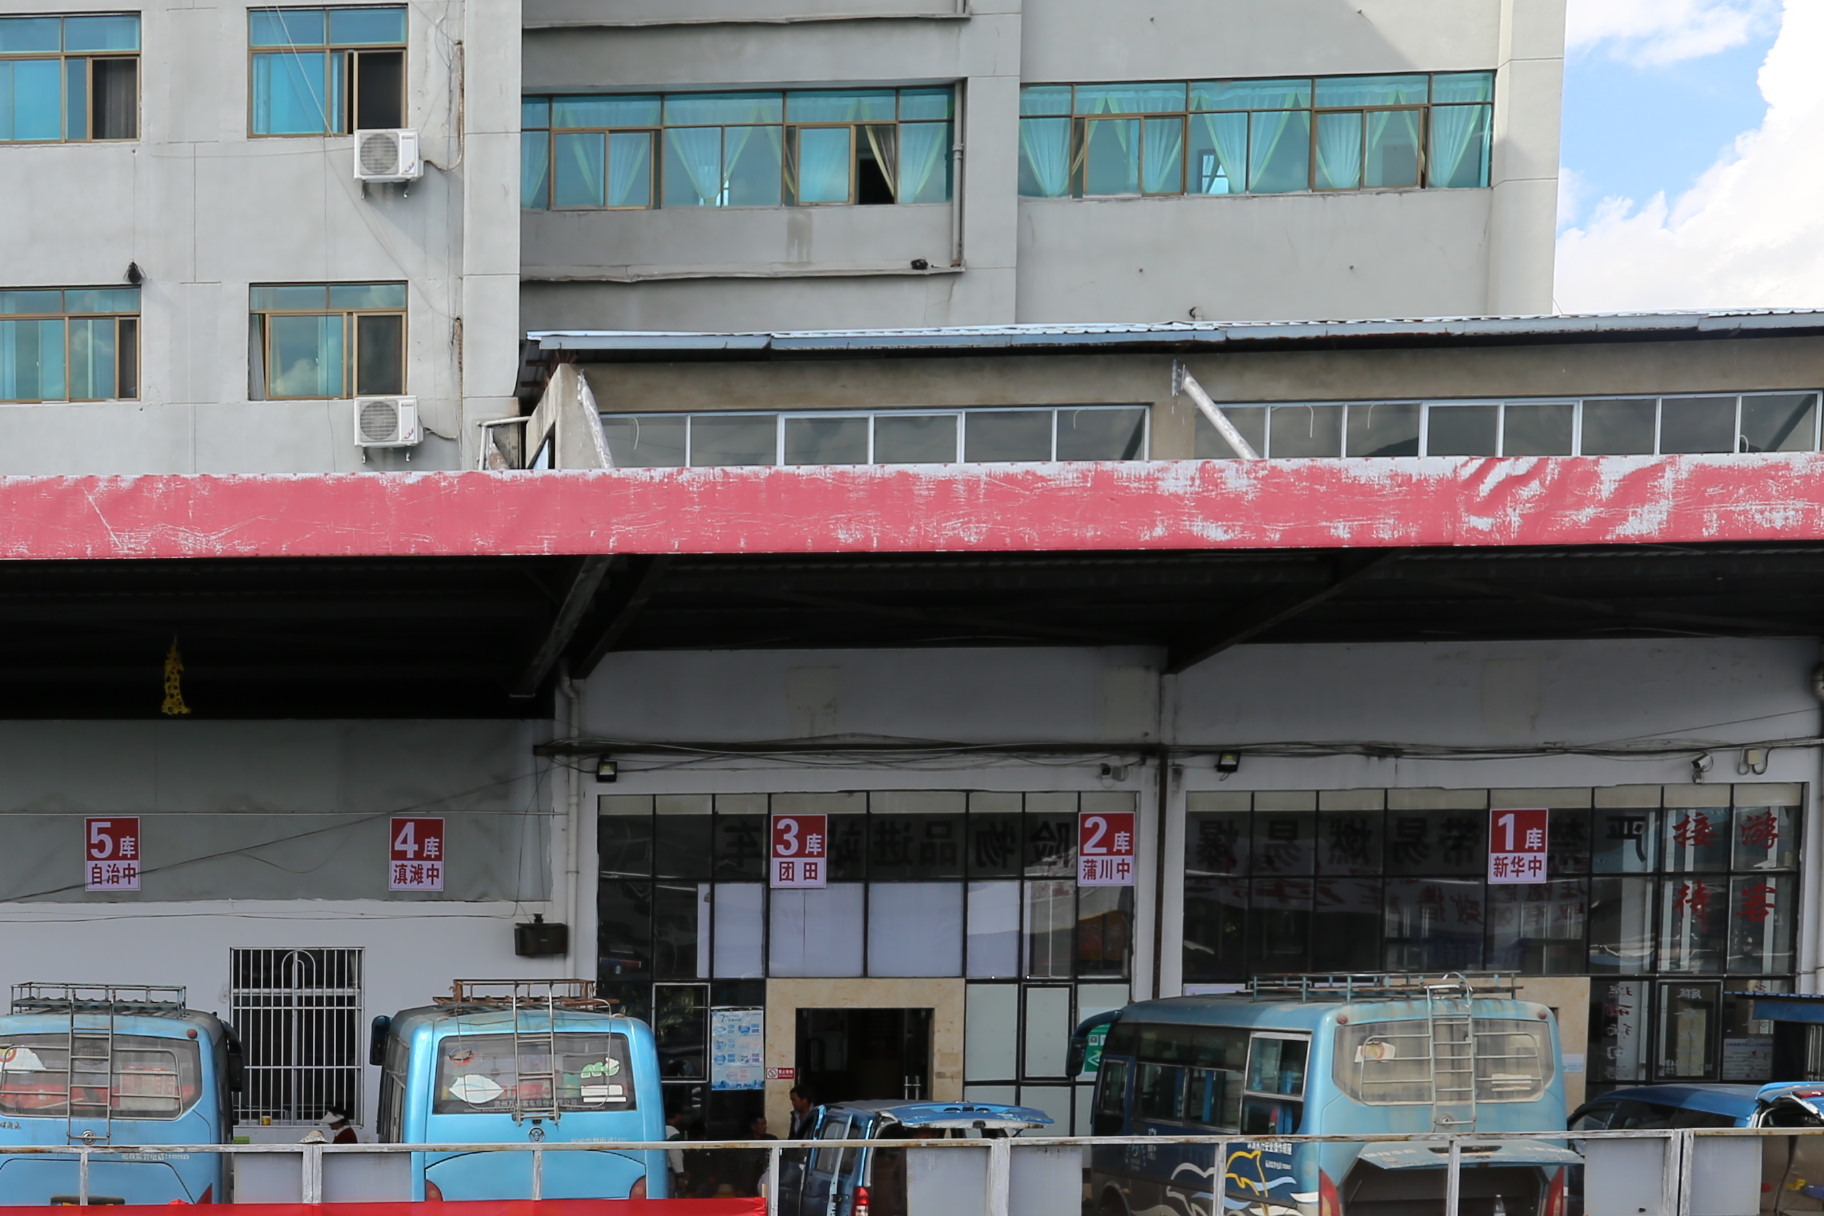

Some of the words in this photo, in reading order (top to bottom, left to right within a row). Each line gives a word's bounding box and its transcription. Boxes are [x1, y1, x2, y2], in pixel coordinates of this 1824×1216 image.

[90, 821, 136, 859] 5库
[394, 822, 440, 859] 4库
[775, 818, 823, 856] 3库
[1082, 816, 1131, 855] 2库
[1497, 813, 1543, 851] 1库
[89, 863, 137, 886] 自治中
[393, 863, 441, 886] 滇滩中
[1082, 858, 1131, 882] 蒲川中
[1492, 855, 1544, 878] 新华中
